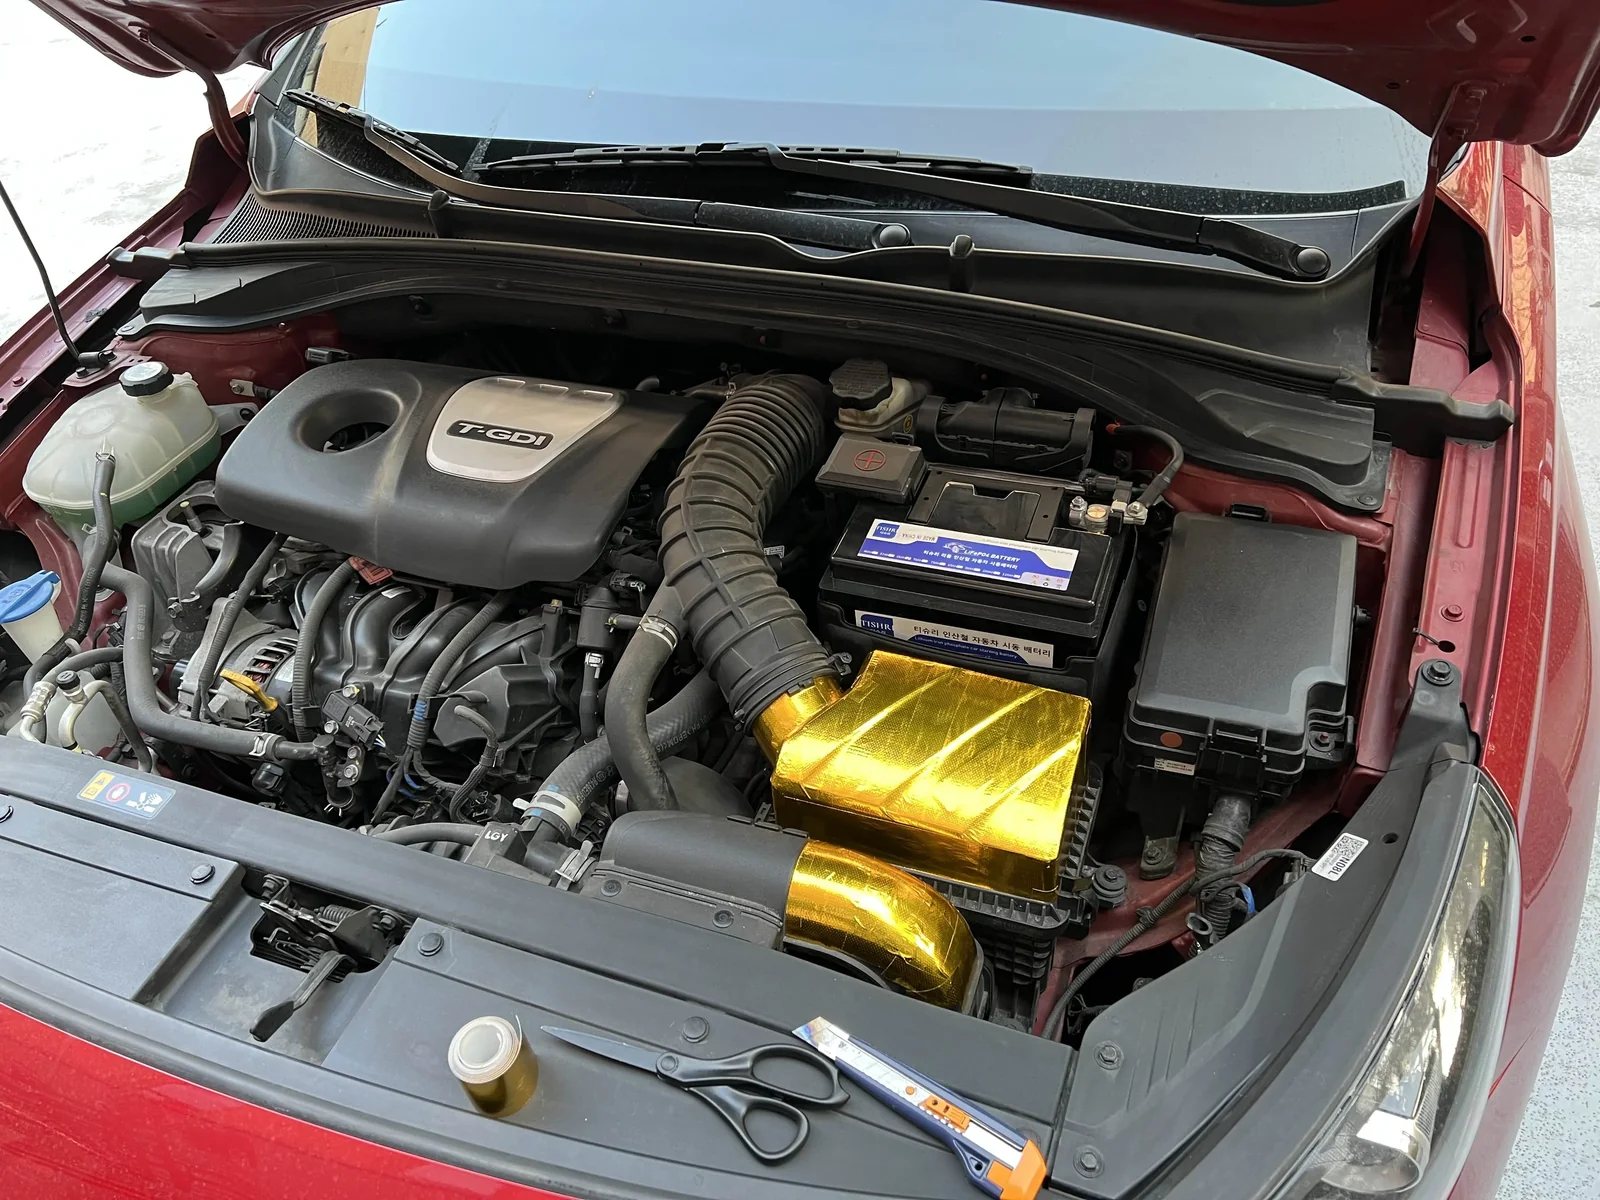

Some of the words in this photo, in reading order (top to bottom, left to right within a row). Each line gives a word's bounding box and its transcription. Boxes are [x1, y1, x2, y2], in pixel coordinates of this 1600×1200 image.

[458, 422, 546, 446] T-GDI
[990, 553, 1021, 563] BATTERY
[913, 625, 939, 636] 티슈리
[942, 630, 969, 641] 인산철
[972, 636, 999, 647] 자동차
[1002, 642, 1020, 651] 시동
[1023, 645, 1051, 657] 배터리
[943, 641, 969, 650] phosphate
[999, 651, 1017, 659] battery
[484, 830, 509, 843] LGY
